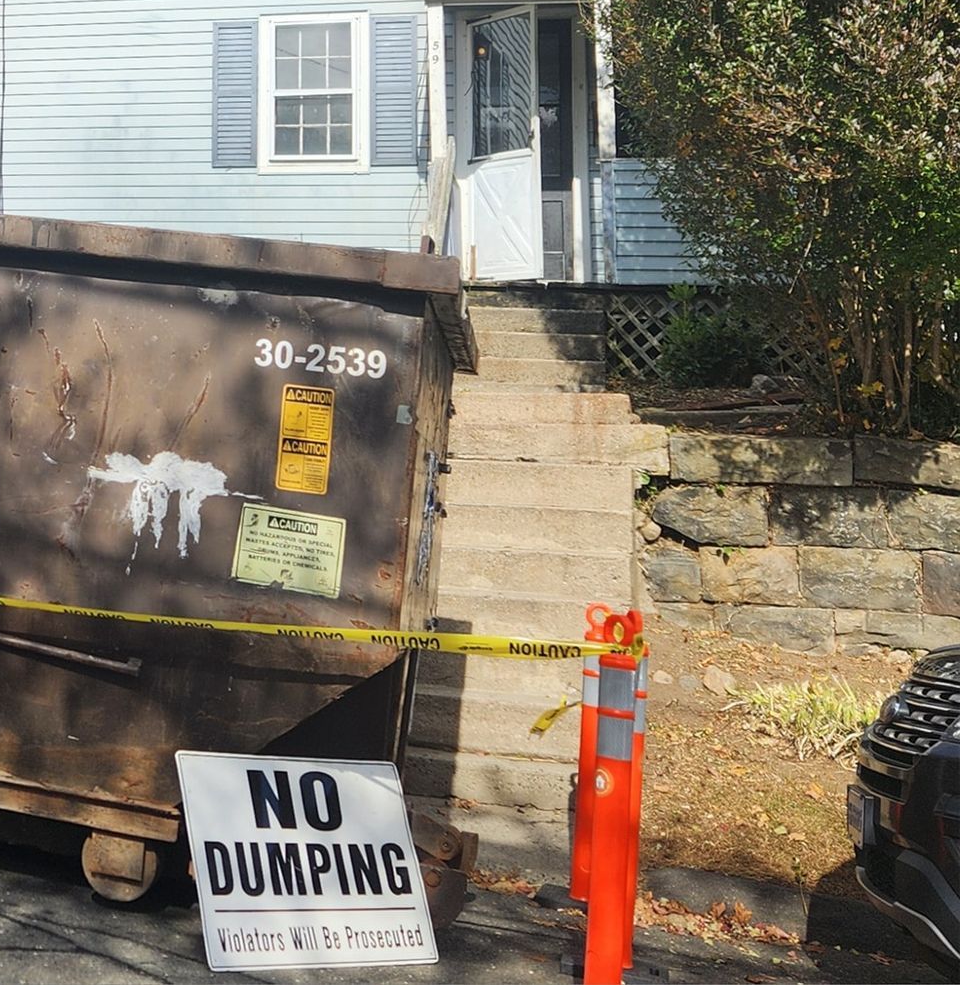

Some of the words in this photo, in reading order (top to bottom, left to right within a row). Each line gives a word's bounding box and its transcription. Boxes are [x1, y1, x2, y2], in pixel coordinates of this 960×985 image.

[254, 338, 387, 379] 30-2539
[295, 389, 332, 405] CAUTION
[291, 441, 327, 455] CAUTION
[279, 519, 317, 535] CAUTION
[245, 537, 270, 546] WASTES
[260, 532, 297, 542] HAZARDOUS
[308, 540, 333, 548] SPECIAL
[248, 554, 281, 564] BATTERIES
[370, 634, 441, 651] CAUTION
[509, 641, 582, 658] CAUTION
[247, 769, 342, 832] NO
[204, 840, 413, 897] DUMPING
[218, 927, 286, 953] Violators
[289, 926, 319, 951] Will
[322, 925, 341, 950] Be
[345, 923, 424, 950] Prosecuted
